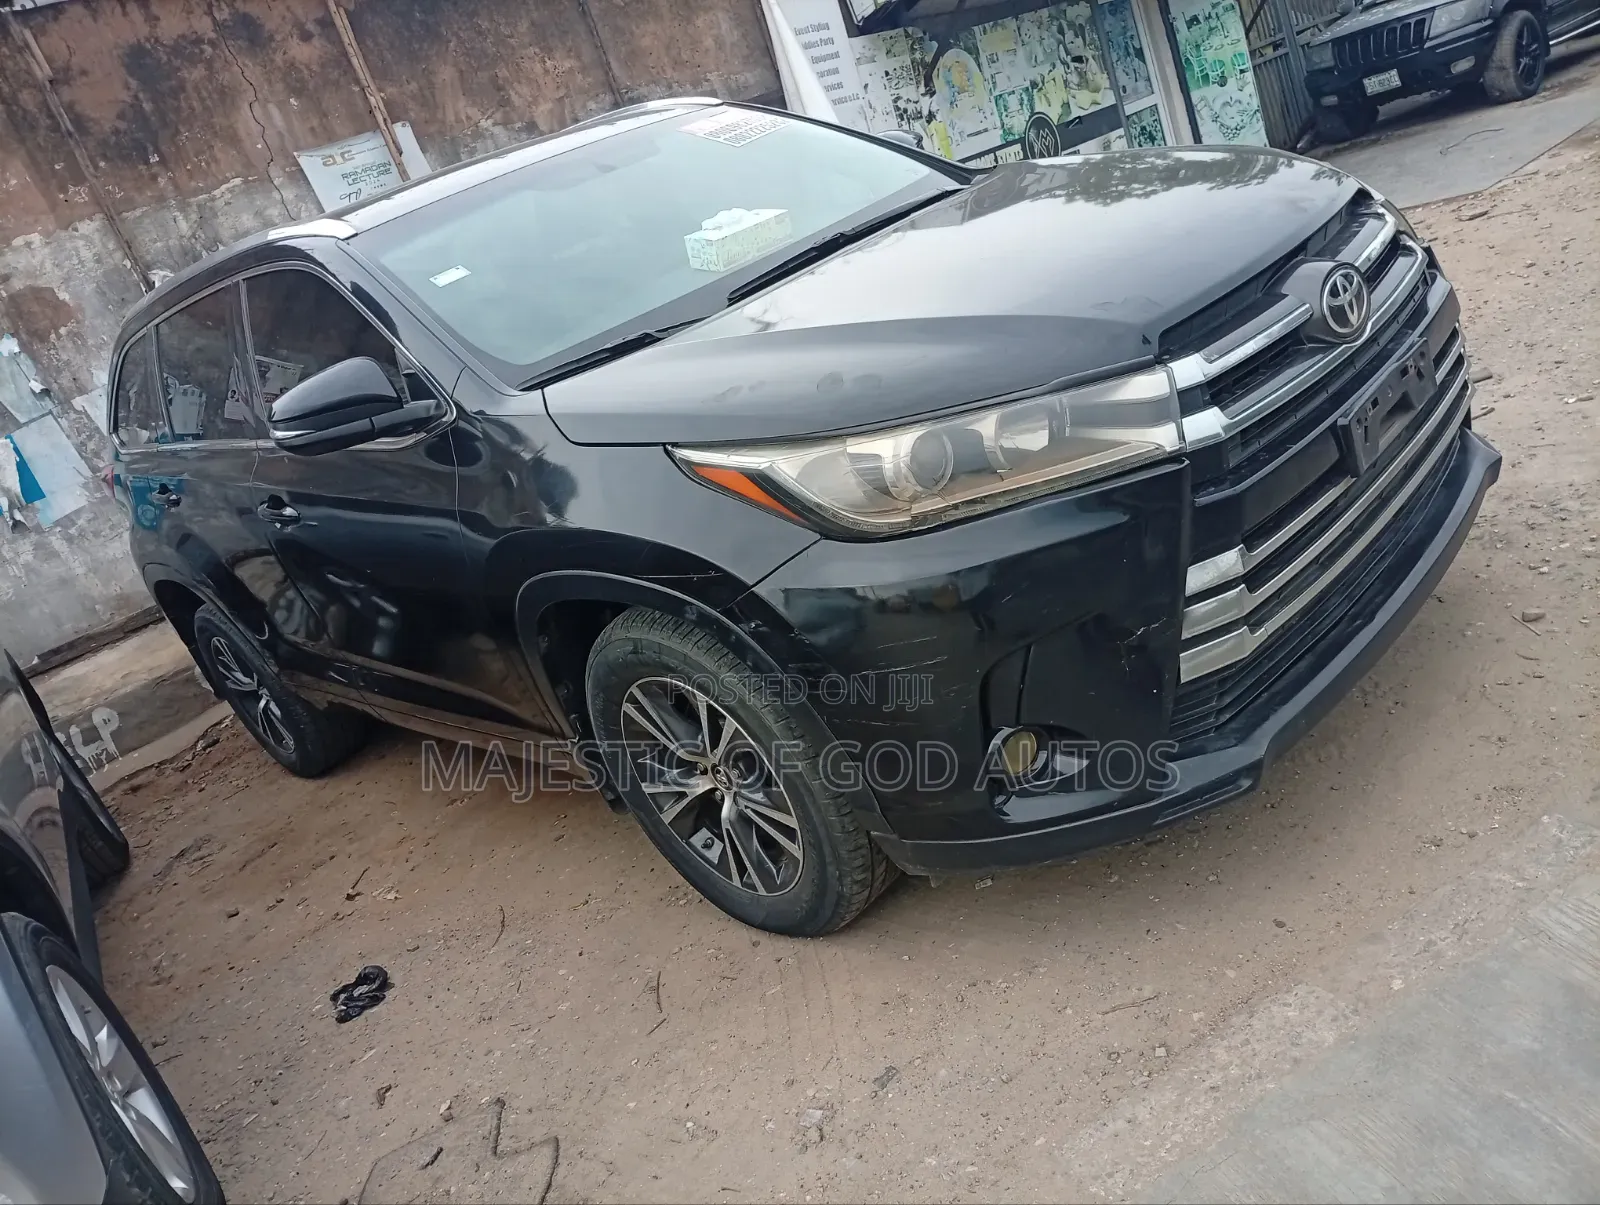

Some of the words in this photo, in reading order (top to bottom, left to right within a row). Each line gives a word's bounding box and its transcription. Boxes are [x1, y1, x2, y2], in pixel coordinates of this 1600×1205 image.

[794, 25, 811, 36] Event
[810, 22, 830, 33] Styling
[819, 36, 835, 47] Party
[811, 50, 840, 64] Equipment
[341, 160, 392, 180] RAMADAN
[346, 167, 393, 187] LECTURE
